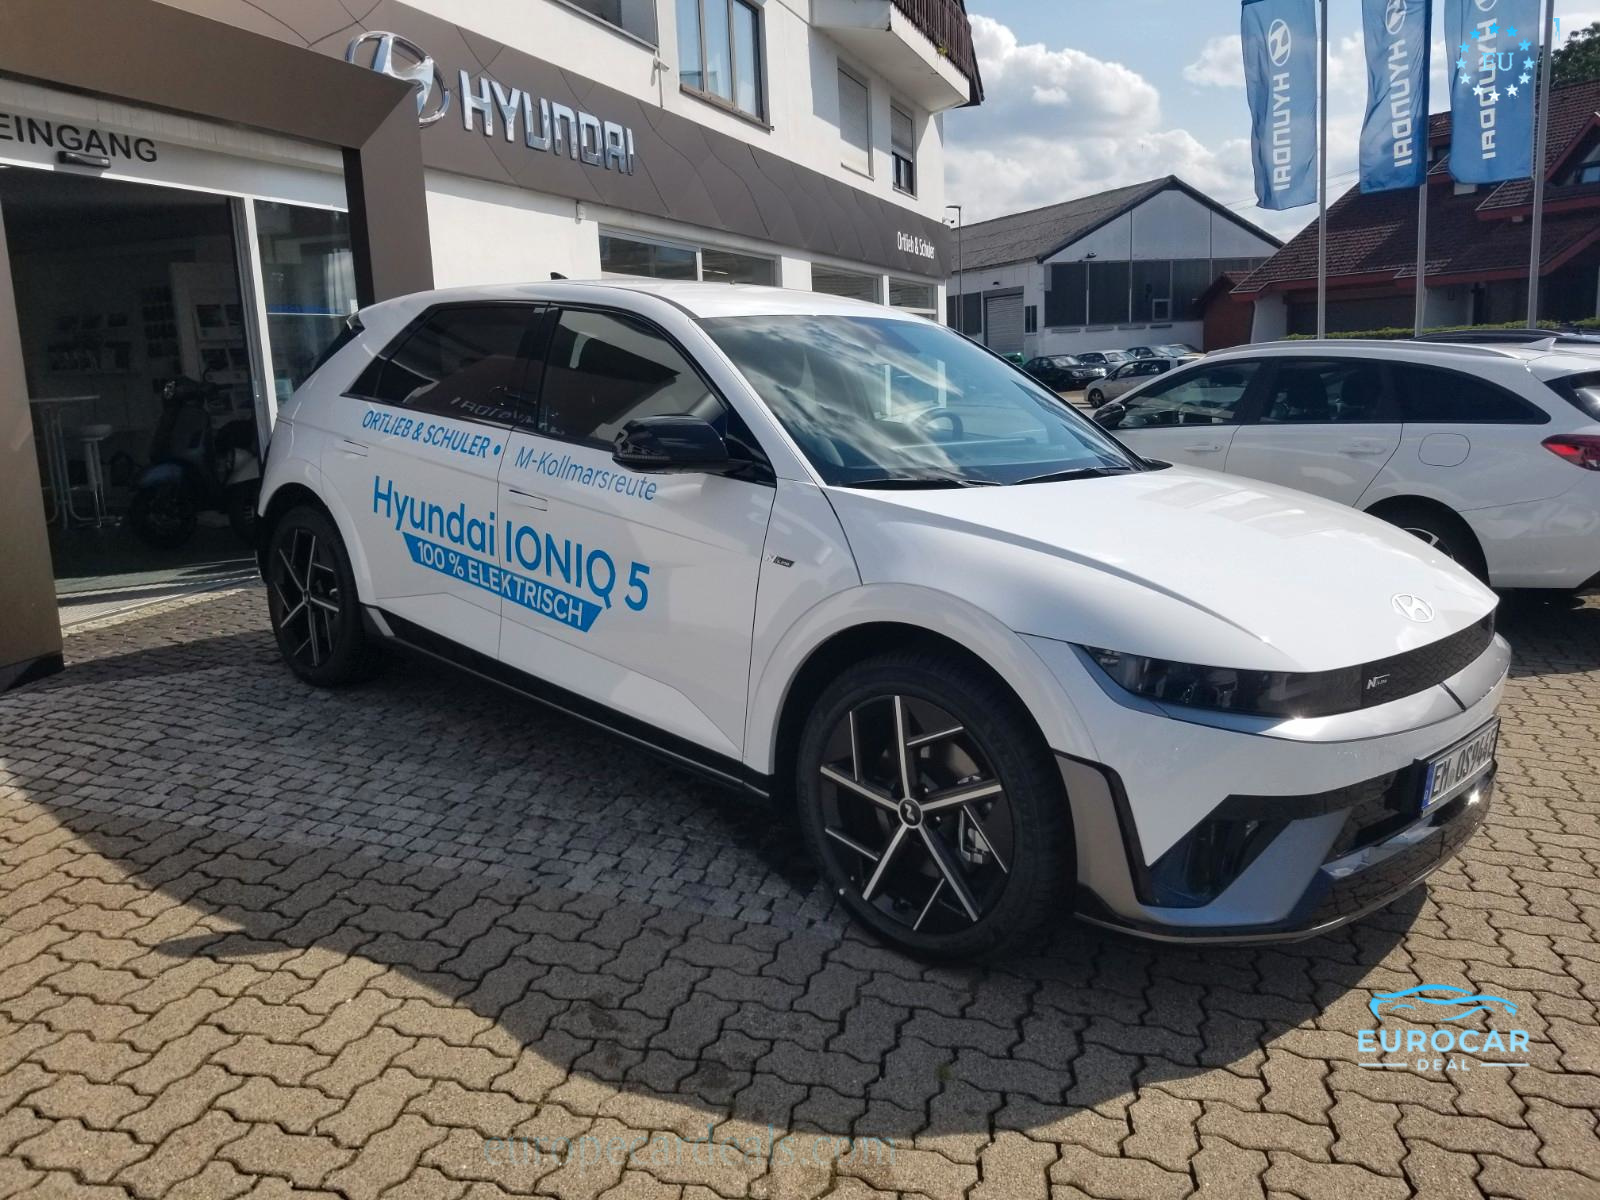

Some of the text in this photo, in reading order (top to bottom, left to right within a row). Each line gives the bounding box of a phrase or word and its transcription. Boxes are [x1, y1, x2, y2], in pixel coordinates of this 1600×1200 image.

[0, 113, 157, 163] EINGANG
[459, 69, 635, 176] HYUNDAI
[1272, 72, 1290, 191] HYUNDAI
[1390, 37, 1412, 168] HYUNDAI
[1475, 18, 1497, 160] HYUNDAI
[362, 410, 491, 459] ORTLIEB & SCHULER
[514, 446, 657, 501] M-Kollmarsreute
[373, 475, 651, 612] Hyundai IONIQ 5
[417, 541, 583, 627] 100 % ELEKTRISCH
